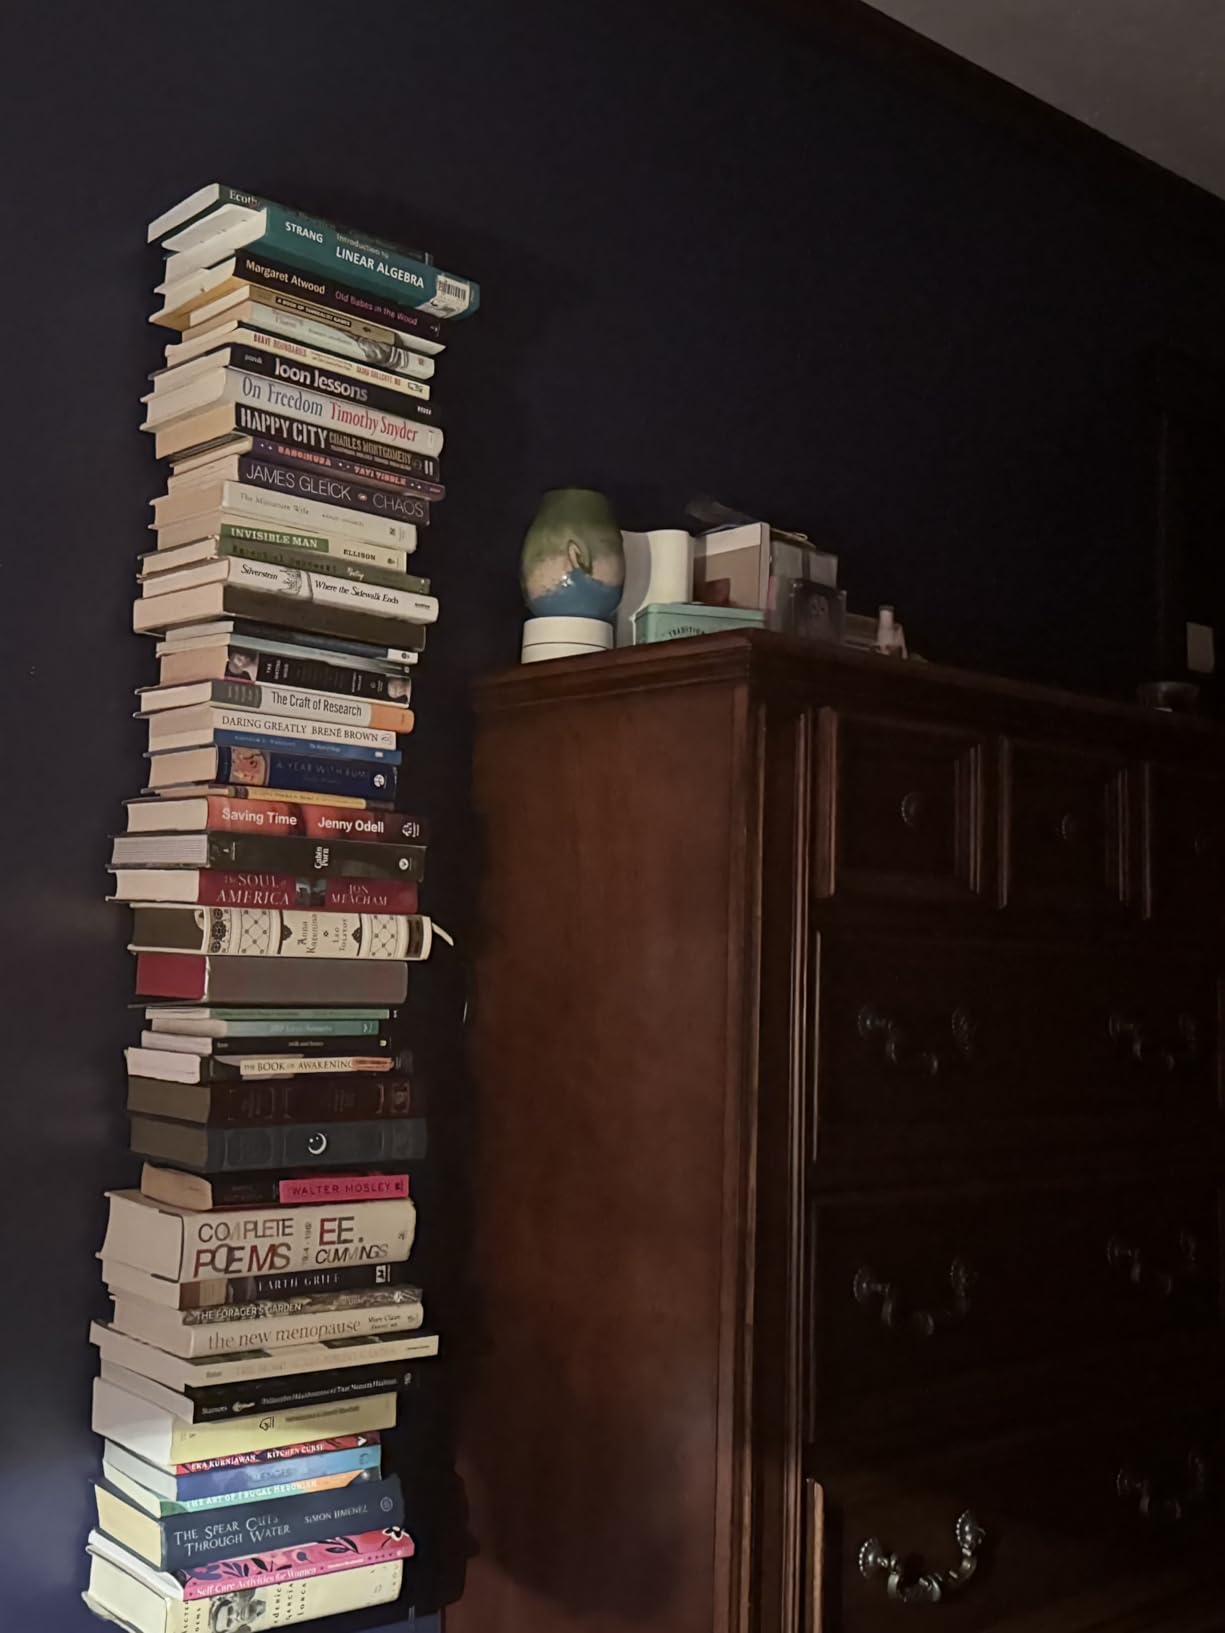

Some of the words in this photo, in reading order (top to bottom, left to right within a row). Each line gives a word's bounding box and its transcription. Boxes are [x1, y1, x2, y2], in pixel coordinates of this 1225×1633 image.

[229, 189, 260, 205] Ecoth
[284, 221, 324, 243] STRANG
[245, 259, 289, 283] Margaret
[290, 274, 326, 295] Atwood
[335, 246, 375, 270] LINEAR
[376, 262, 425, 289] ALGEBRA
[335, 290, 349, 303] Old
[397, 310, 418, 326] Wood
[274, 358, 311, 385] loon
[313, 369, 369, 402] lessons
[242, 376, 261, 399] On
[268, 383, 323, 416] Freedom
[330, 400, 378, 436] Timothy
[380, 416, 419, 442] Snyder
[240, 407, 290, 438] HAPPY
[292, 421, 328, 449] CITY
[246, 464, 296, 488] JAMES
[299, 475, 352, 502] GLEICK
[372, 493, 424, 518] CHAOS
[230, 527, 290, 545] INVISIBLE
[292, 536, 318, 549] MAN
[343, 549, 376, 561] ELLISON
[315, 580, 338, 593] Where
[338, 585, 349, 595] the
[351, 586, 382, 601] Sidewalk
[382, 594, 399, 605] Ends
[271, 690, 288, 706] The
[289, 694, 310, 709] Craft
[312, 698, 322, 710] of
[323, 699, 362, 717] Research
[222, 715, 262, 729] DARING
[263, 720, 307, 734] GREATLY
[311, 725, 342, 739] BRENÉ
[344, 731, 379, 742] BROWN
[221, 807, 264, 826] Saving
[266, 811, 298, 826] Time
[318, 816, 353, 833] Jenny
[354, 819, 384, 833] Odell
[238, 873, 279, 888] SOUL
[216, 889, 289, 905] AMERICA
[331, 892, 388, 906] MEACHAM
[257, 1061, 286, 1071] BOOK
[292, 1184, 339, 1196] WALTER
[345, 1182, 391, 1193] MOSLEY
[193, 1242, 292, 1279] POEMS
[196, 1310, 216, 1321] THE
[216, 1305, 264, 1319] FORAGER'S
[267, 1302, 303, 1314] GARDEN
[208, 1331, 235, 1350] the
[239, 1330, 272, 1347] new
[276, 1320, 361, 1342] menopause
[173, 1528, 199, 1546] THE
[204, 1521, 240, 1540] SPEAR
[183, 1533, 243, 1557] THROUGH
[249, 1524, 291, 1543] WATER
